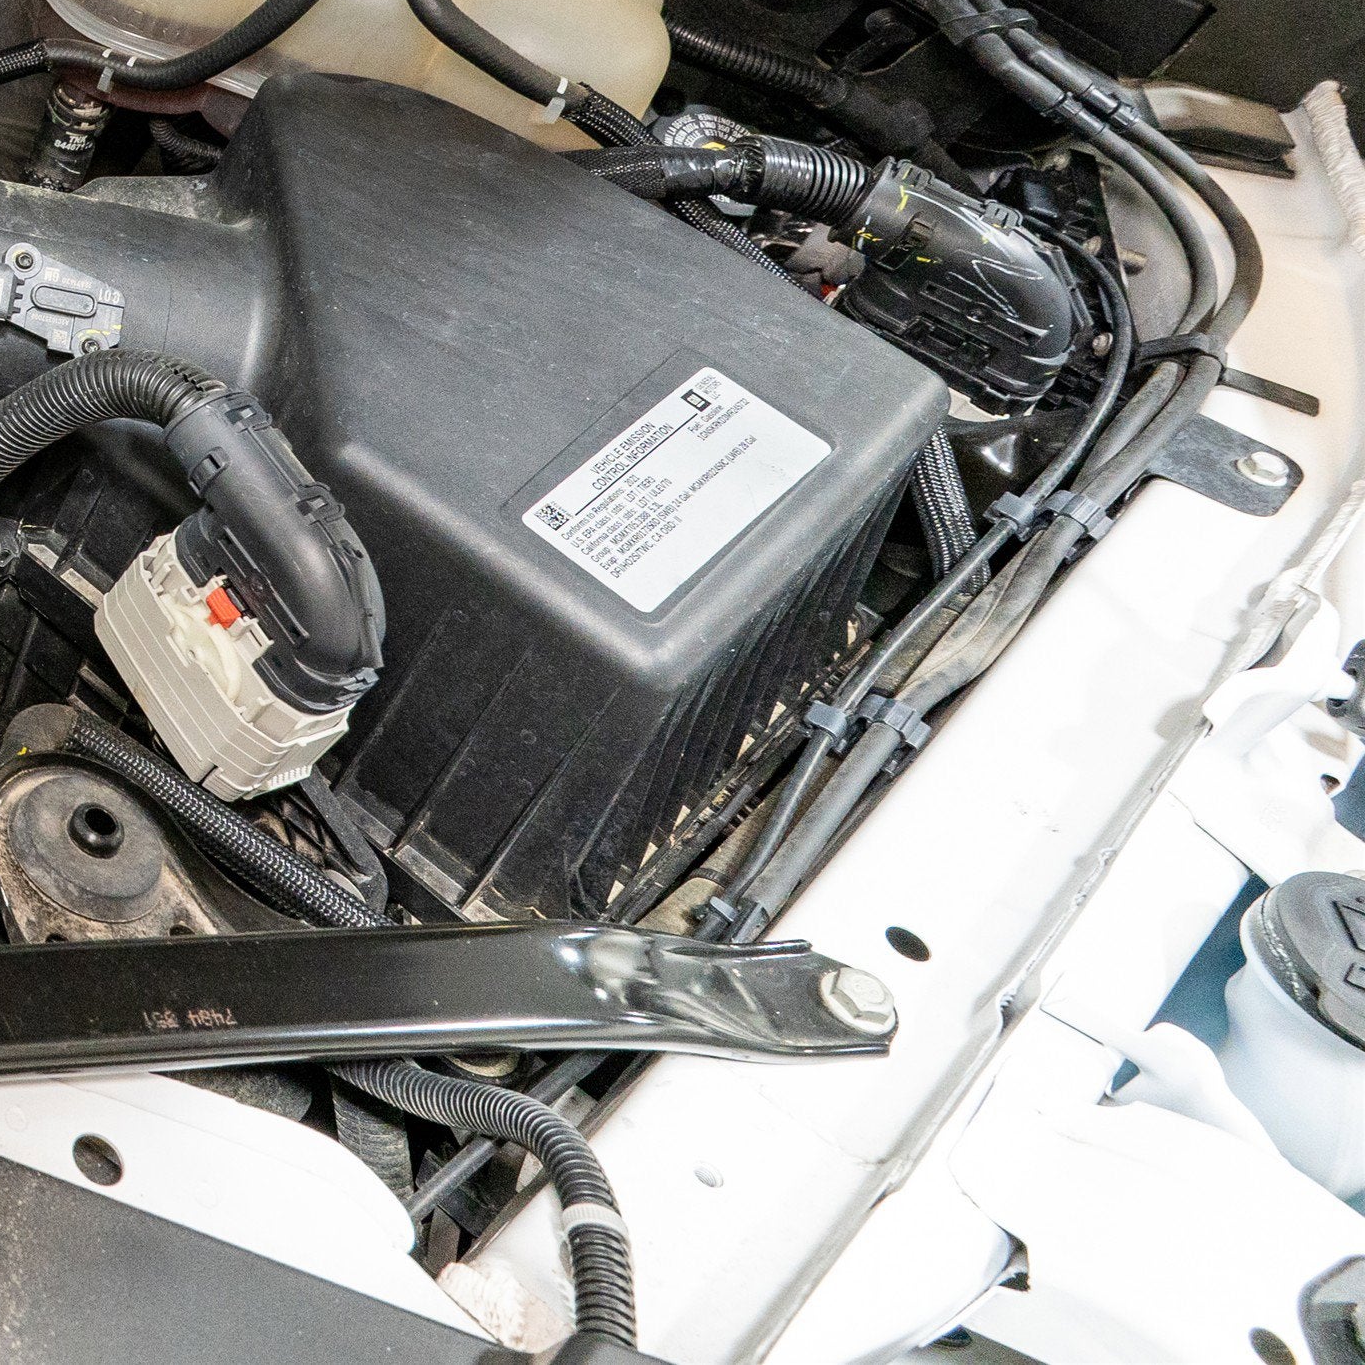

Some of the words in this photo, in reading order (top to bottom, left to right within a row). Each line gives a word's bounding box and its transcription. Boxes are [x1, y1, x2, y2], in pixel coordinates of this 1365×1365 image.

[700, 404, 723, 422] Gasoline
[702, 380, 721, 394] MOTORS
[590, 447, 624, 474] VEHICLE
[619, 423, 655, 450] EMISSION
[592, 462, 629, 490] CONTROL
[626, 425, 673, 460] INFORMATION
[656, 504, 677, 521] (SWB)
[744, 435, 757, 445] Gal
[560, 517, 589, 540] Conforms
[591, 488, 624, 514] Regulations:
[623, 474, 639, 487] 2021
[580, 532, 608, 555] California
[606, 520, 622, 534] class
[635, 495, 649, 508] LDT
[581, 526, 596, 538] EPA
[594, 515, 611, 529] class
[624, 489, 637, 502] LDT
[636, 476, 655, 489] TIER3
[650, 532, 663, 542] CA
